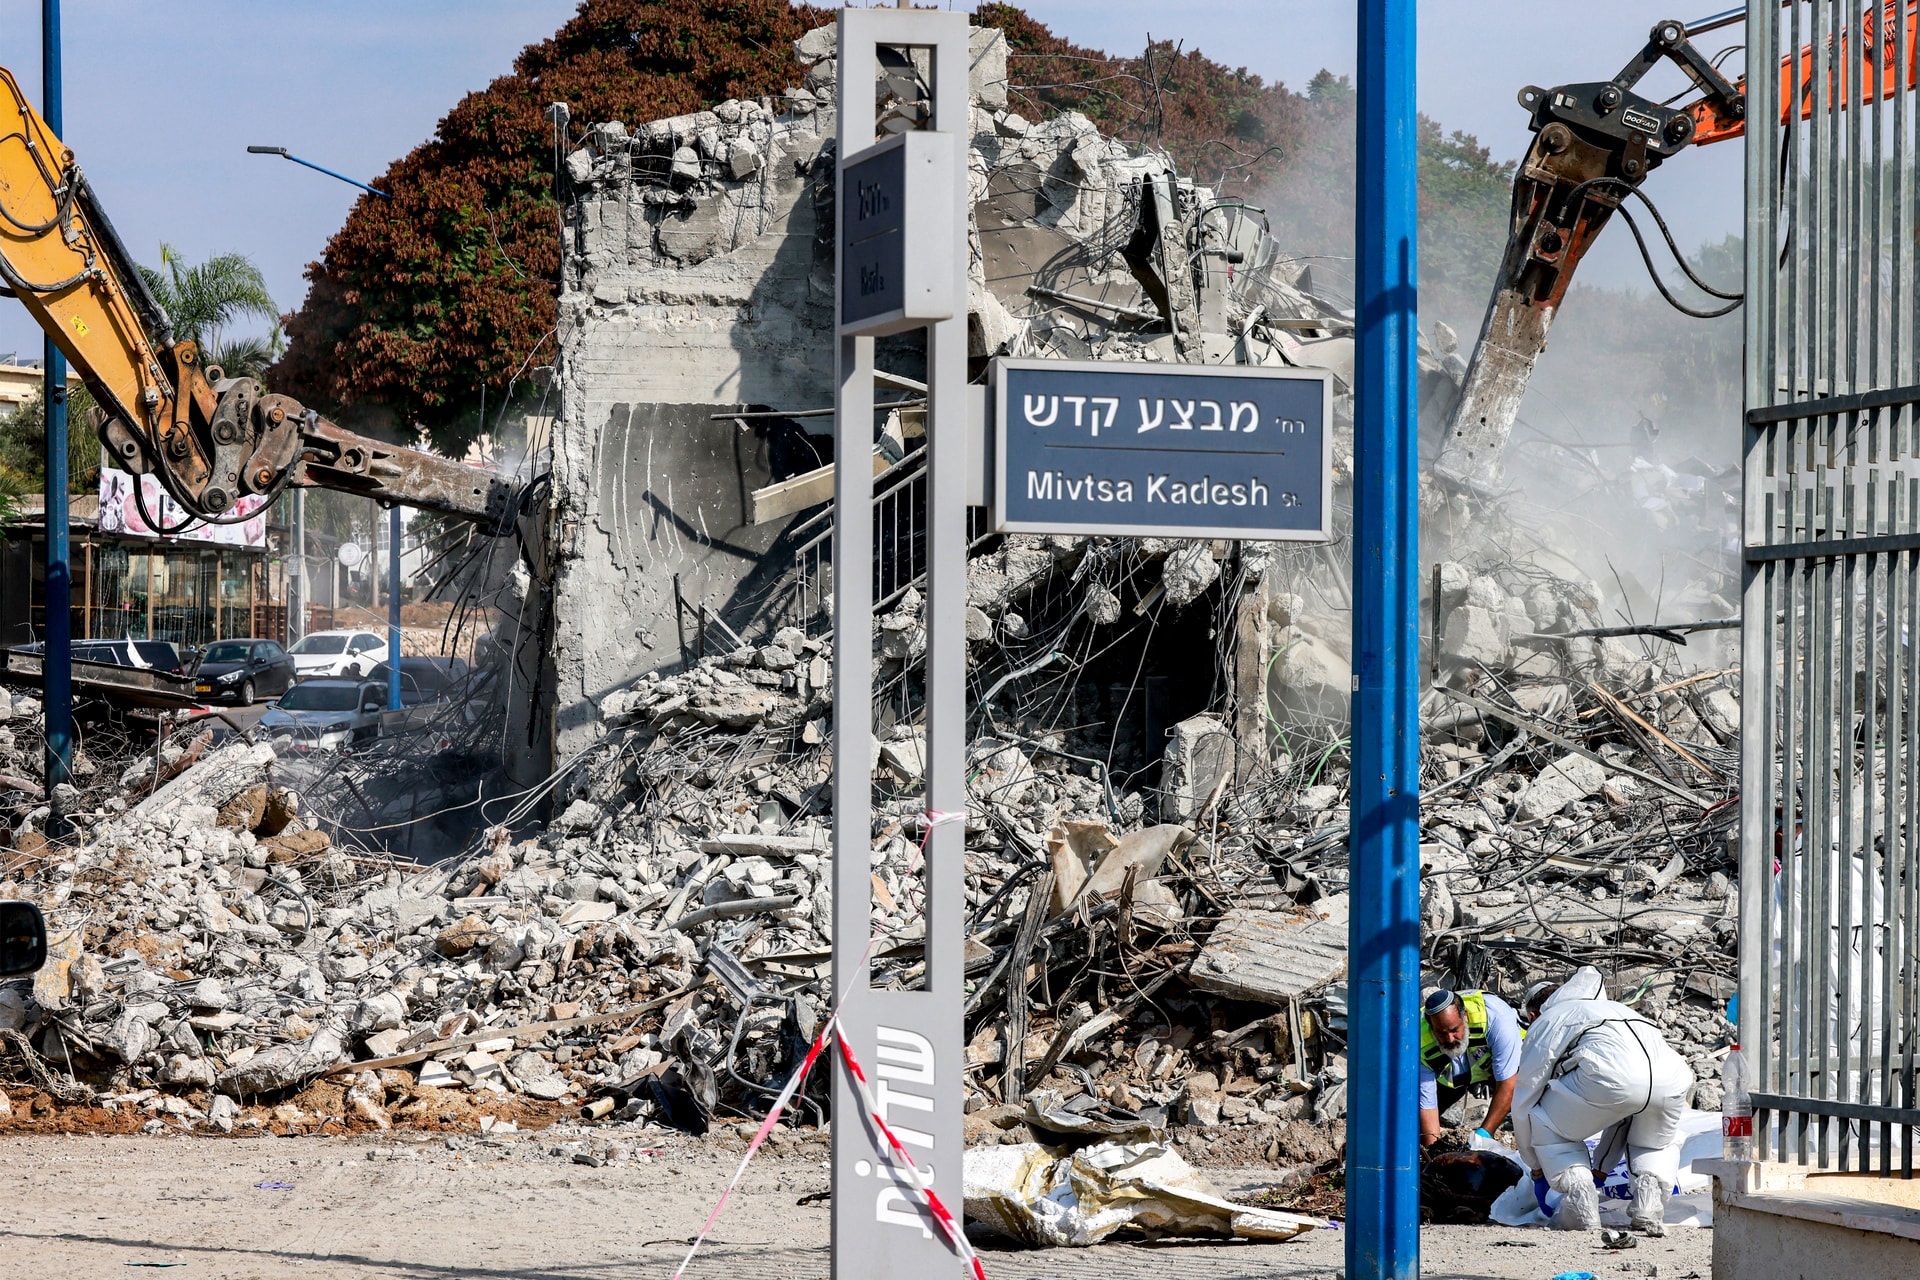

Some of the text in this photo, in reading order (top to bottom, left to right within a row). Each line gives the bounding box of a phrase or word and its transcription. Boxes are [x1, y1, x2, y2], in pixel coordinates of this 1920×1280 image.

[1023, 394, 1119, 437] קדש
[1137, 398, 1259, 434] מבצע
[1027, 470, 1134, 503] Mivtsa
[1147, 475, 1269, 506] Kadesh
